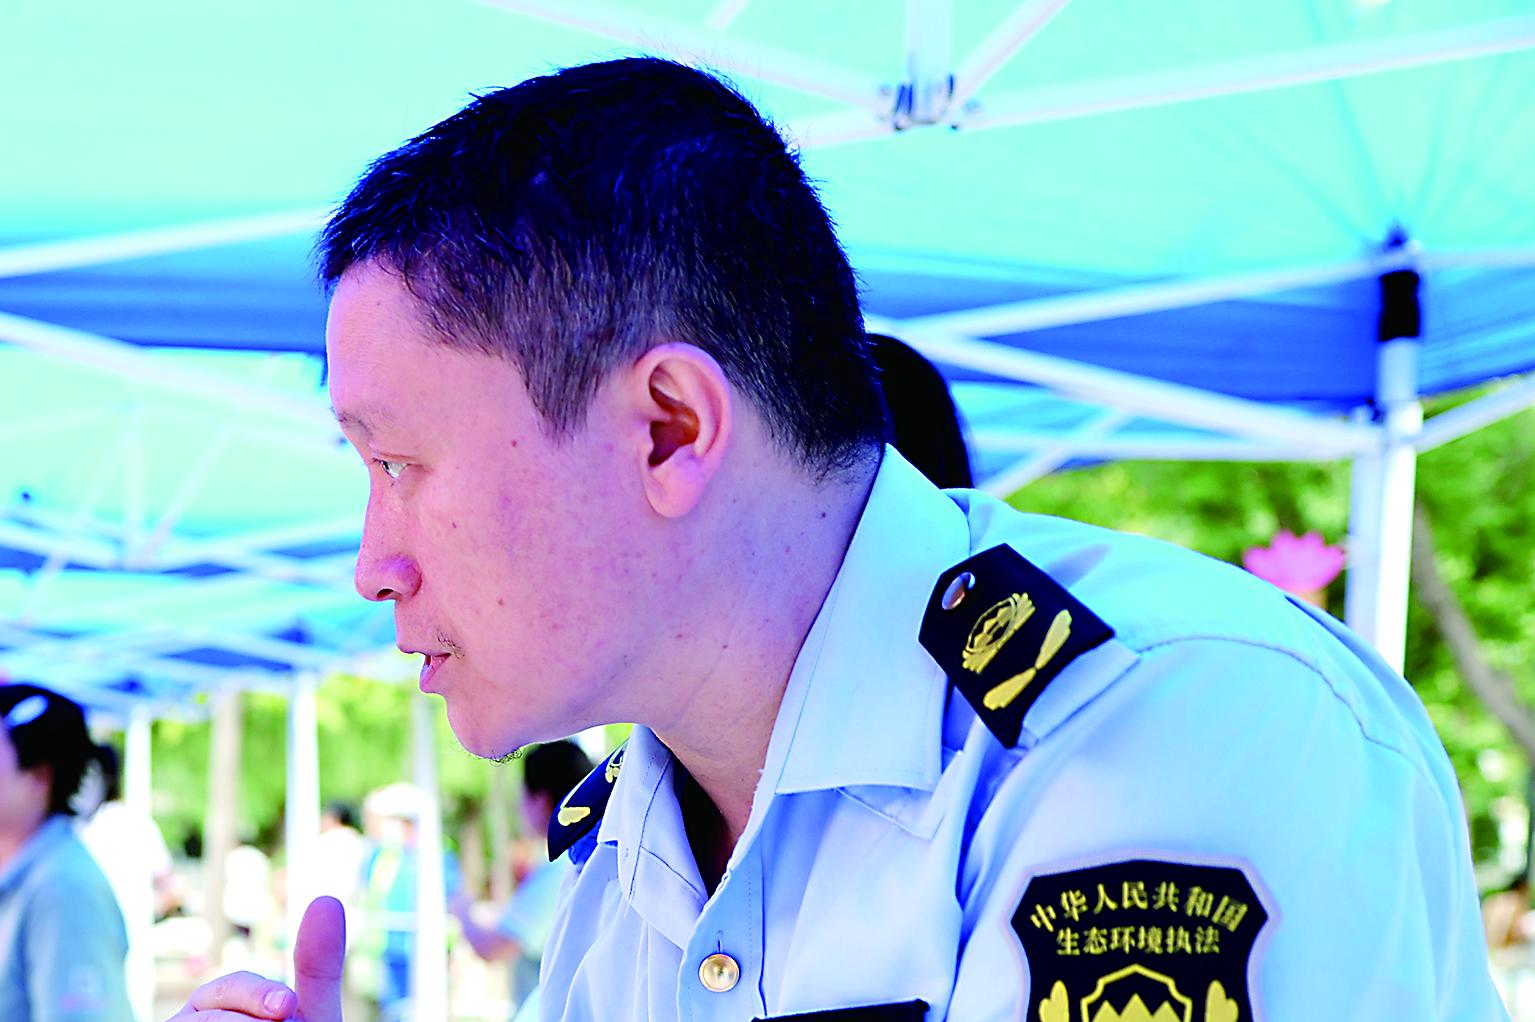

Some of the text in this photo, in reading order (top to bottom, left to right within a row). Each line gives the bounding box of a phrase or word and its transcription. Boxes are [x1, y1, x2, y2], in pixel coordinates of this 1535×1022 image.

[1029, 880, 1249, 934] 中华人民共和国
[1055, 926, 1221, 956] 生态环境执法
